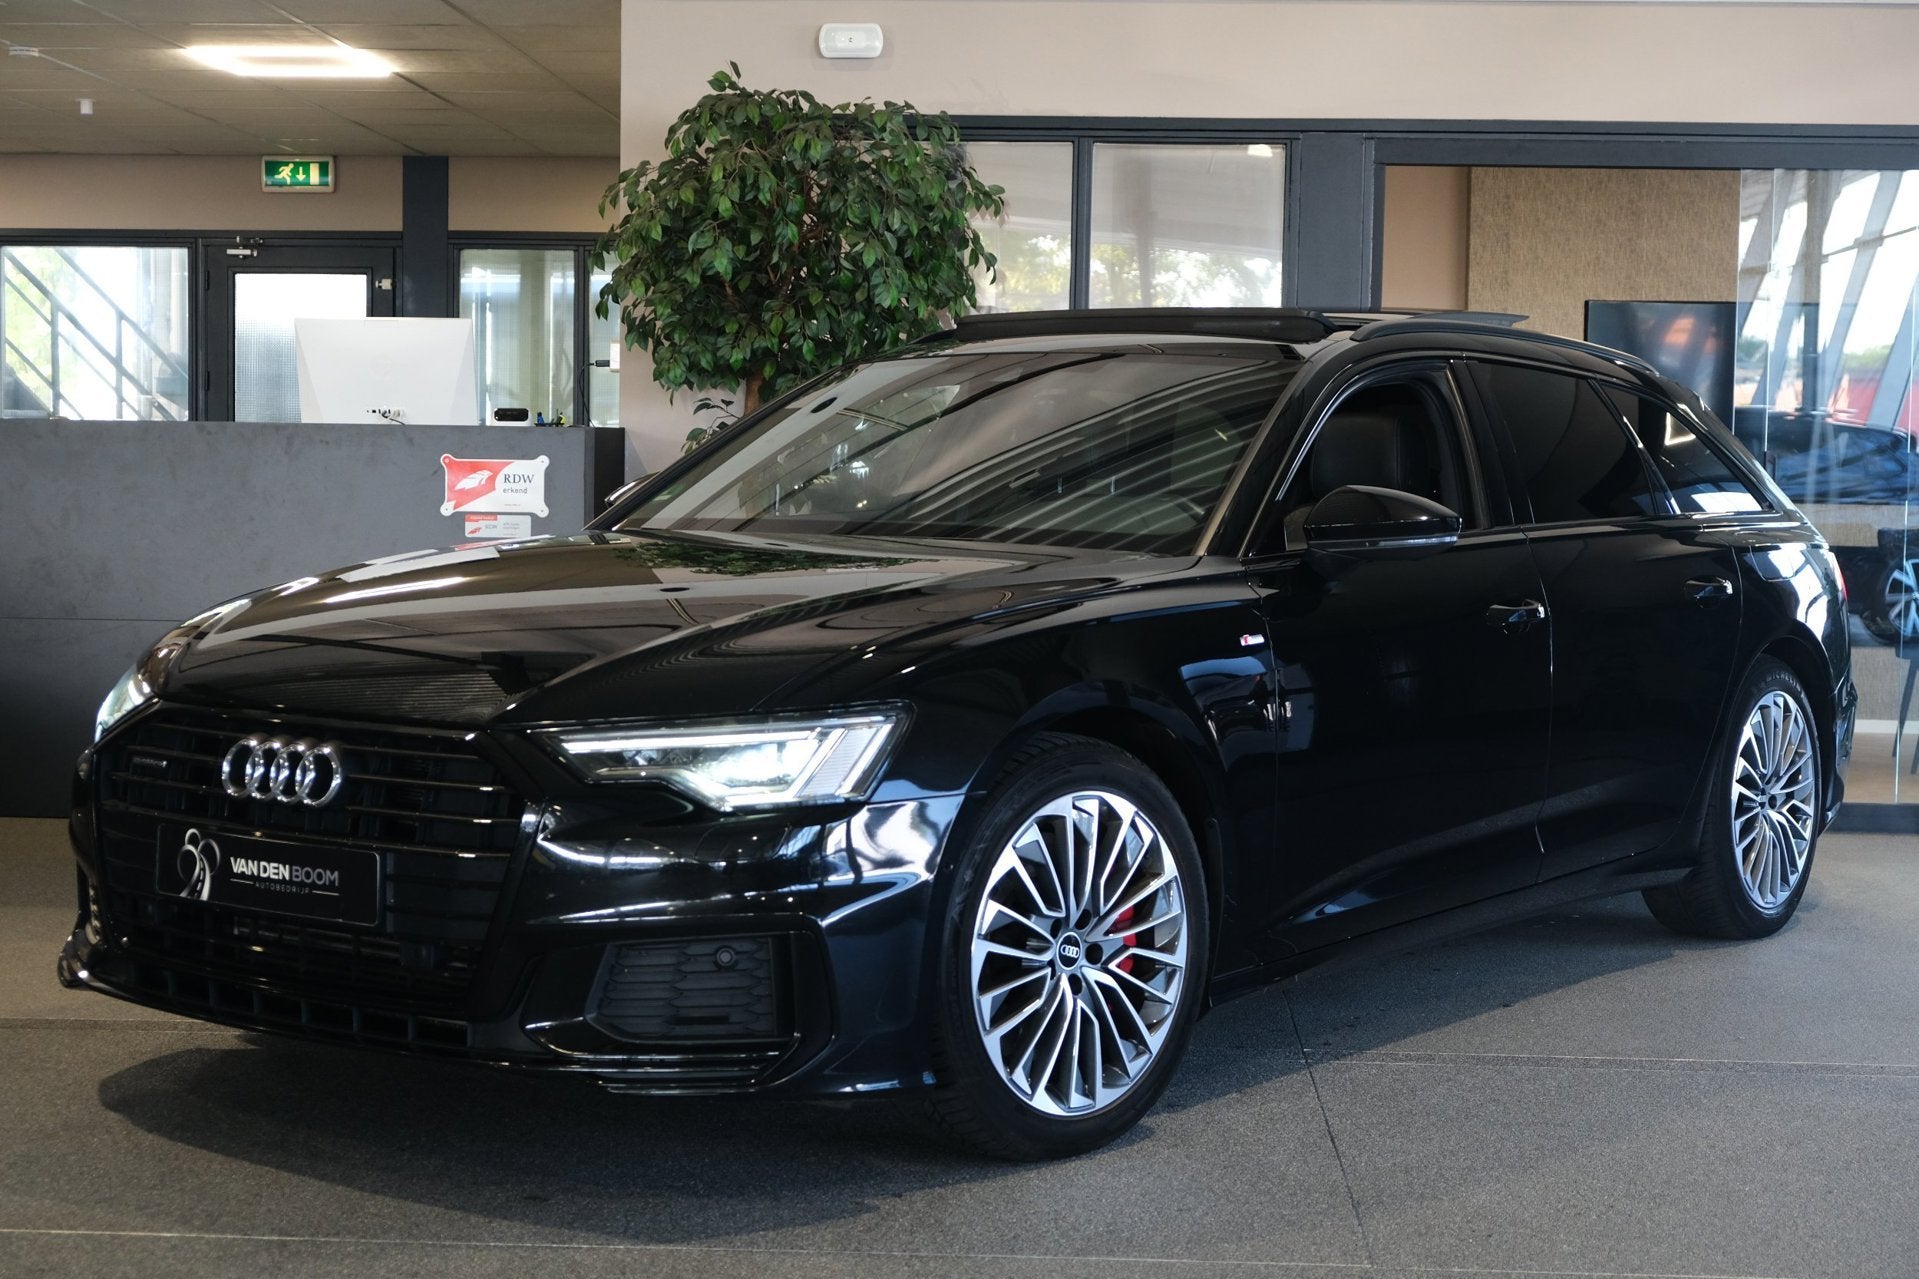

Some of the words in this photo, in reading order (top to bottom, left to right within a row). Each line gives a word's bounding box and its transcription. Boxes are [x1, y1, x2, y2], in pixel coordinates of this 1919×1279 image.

[503, 473, 535, 484] RDW
[502, 486, 528, 494] erkend
[230, 856, 258, 877] VAN
[259, 860, 291, 881] DEN
[292, 865, 339, 887] BOOM
[255, 881, 310, 895] AUTOBEDRIJF
